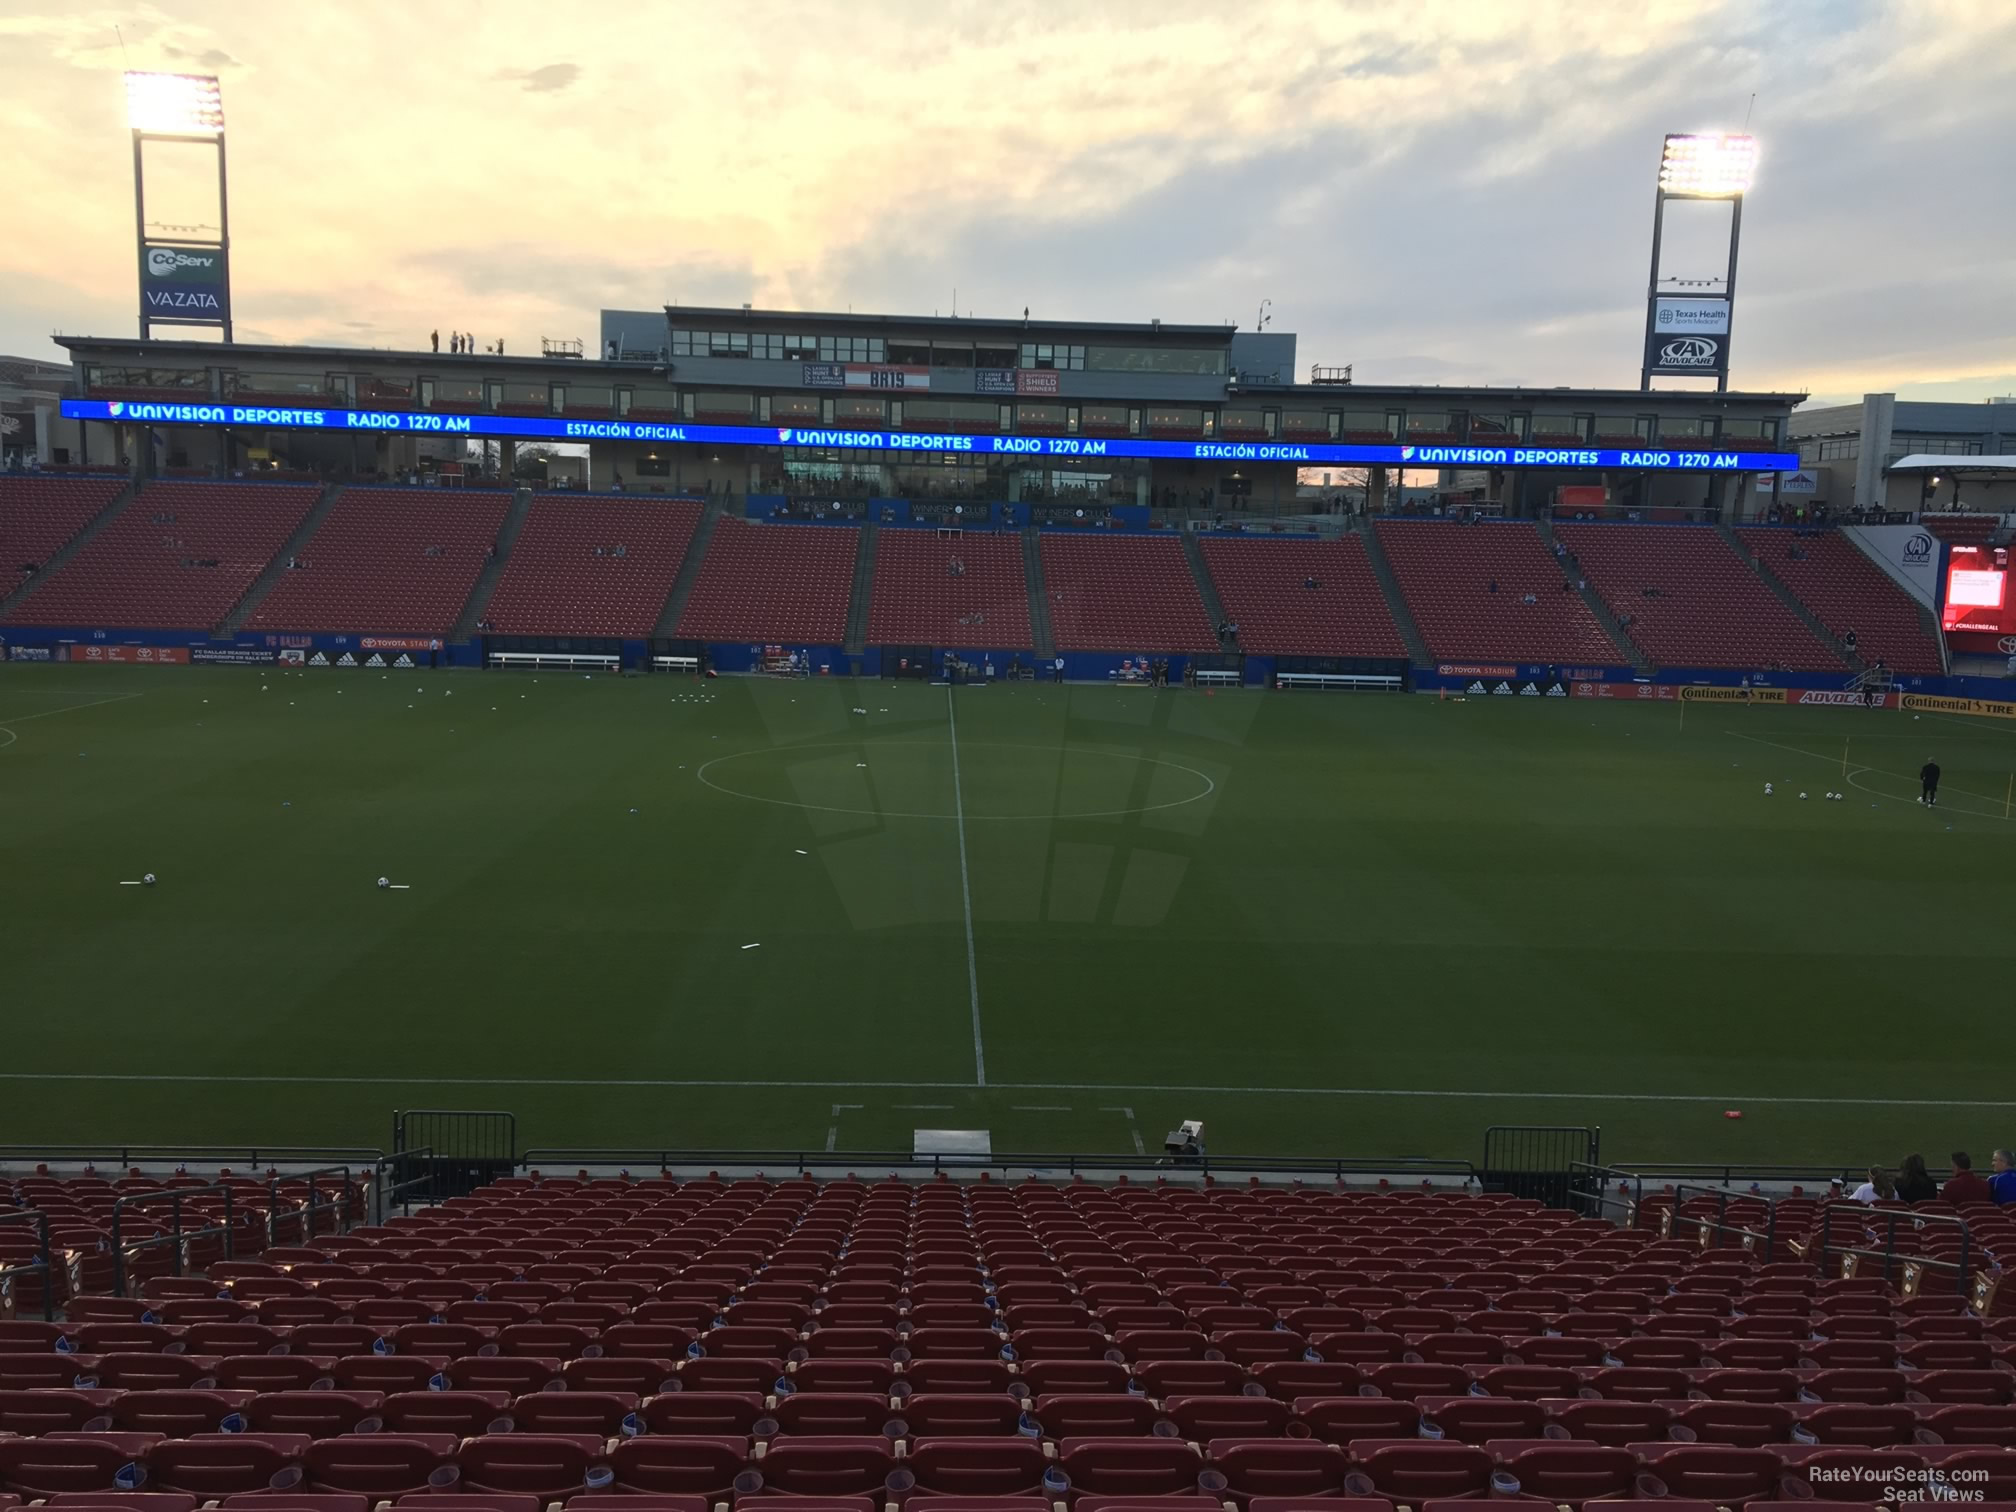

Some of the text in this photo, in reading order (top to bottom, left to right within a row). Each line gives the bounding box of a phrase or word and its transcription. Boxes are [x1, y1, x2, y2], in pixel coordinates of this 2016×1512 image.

[153, 254, 213, 267] CoServ
[147, 291, 219, 308] VAZATA
[1675, 310, 1726, 318] Texas Health
[1659, 356, 1715, 366] ADVOCARE
[870, 371, 905, 388] BR19
[233, 408, 324, 425] DEPORTES
[348, 413, 400, 428] RADIO
[408, 415, 441, 430] 1270
[445, 417, 471, 431] AM
[567, 422, 686, 440] ESTACIÓN OFICIAL
[890, 435, 972, 450] DEPORTES
[994, 438, 1041, 452] RADIO
[1048, 440, 1079, 453] 1270
[1083, 441, 1106, 454] AM
[1195, 443, 1309, 459] ESTACIÓN OFICIAL
[1514, 450, 1598, 464] DEPORTES
[1621, 452, 1670, 466] RADIO
[1677, 453, 1710, 467] 1270
[1713, 454, 1738, 468] AM
[841, 503, 865, 512] CLUB
[1955, 623, 1998, 631] #CHALLENGEALL
[1758, 691, 1784, 700] TIRE
[1902, 695, 2014, 714] Continental TIRE
